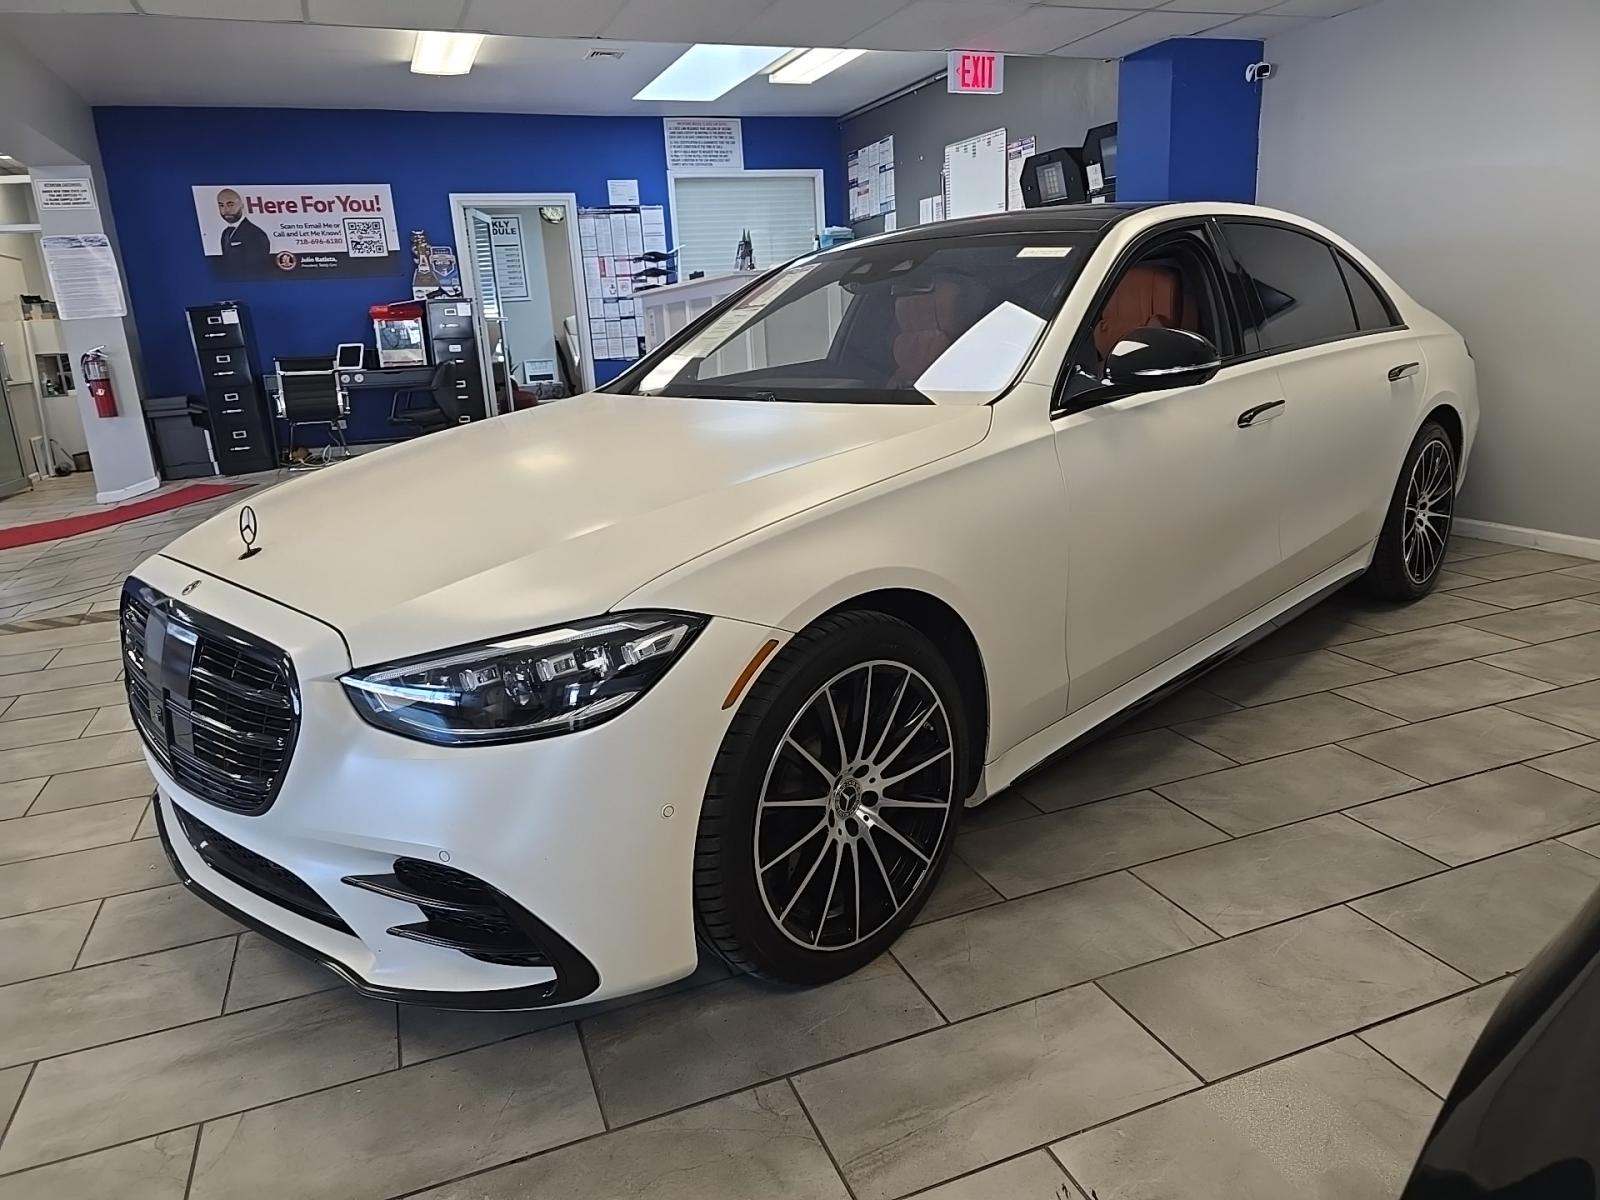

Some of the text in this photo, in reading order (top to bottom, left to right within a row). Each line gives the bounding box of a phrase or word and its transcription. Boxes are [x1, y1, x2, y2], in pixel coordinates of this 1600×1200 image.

[961, 55, 995, 88] EXIT
[245, 195, 382, 214] Here For You!
[491, 220, 510, 228] KLY
[491, 227, 517, 235] DULE
